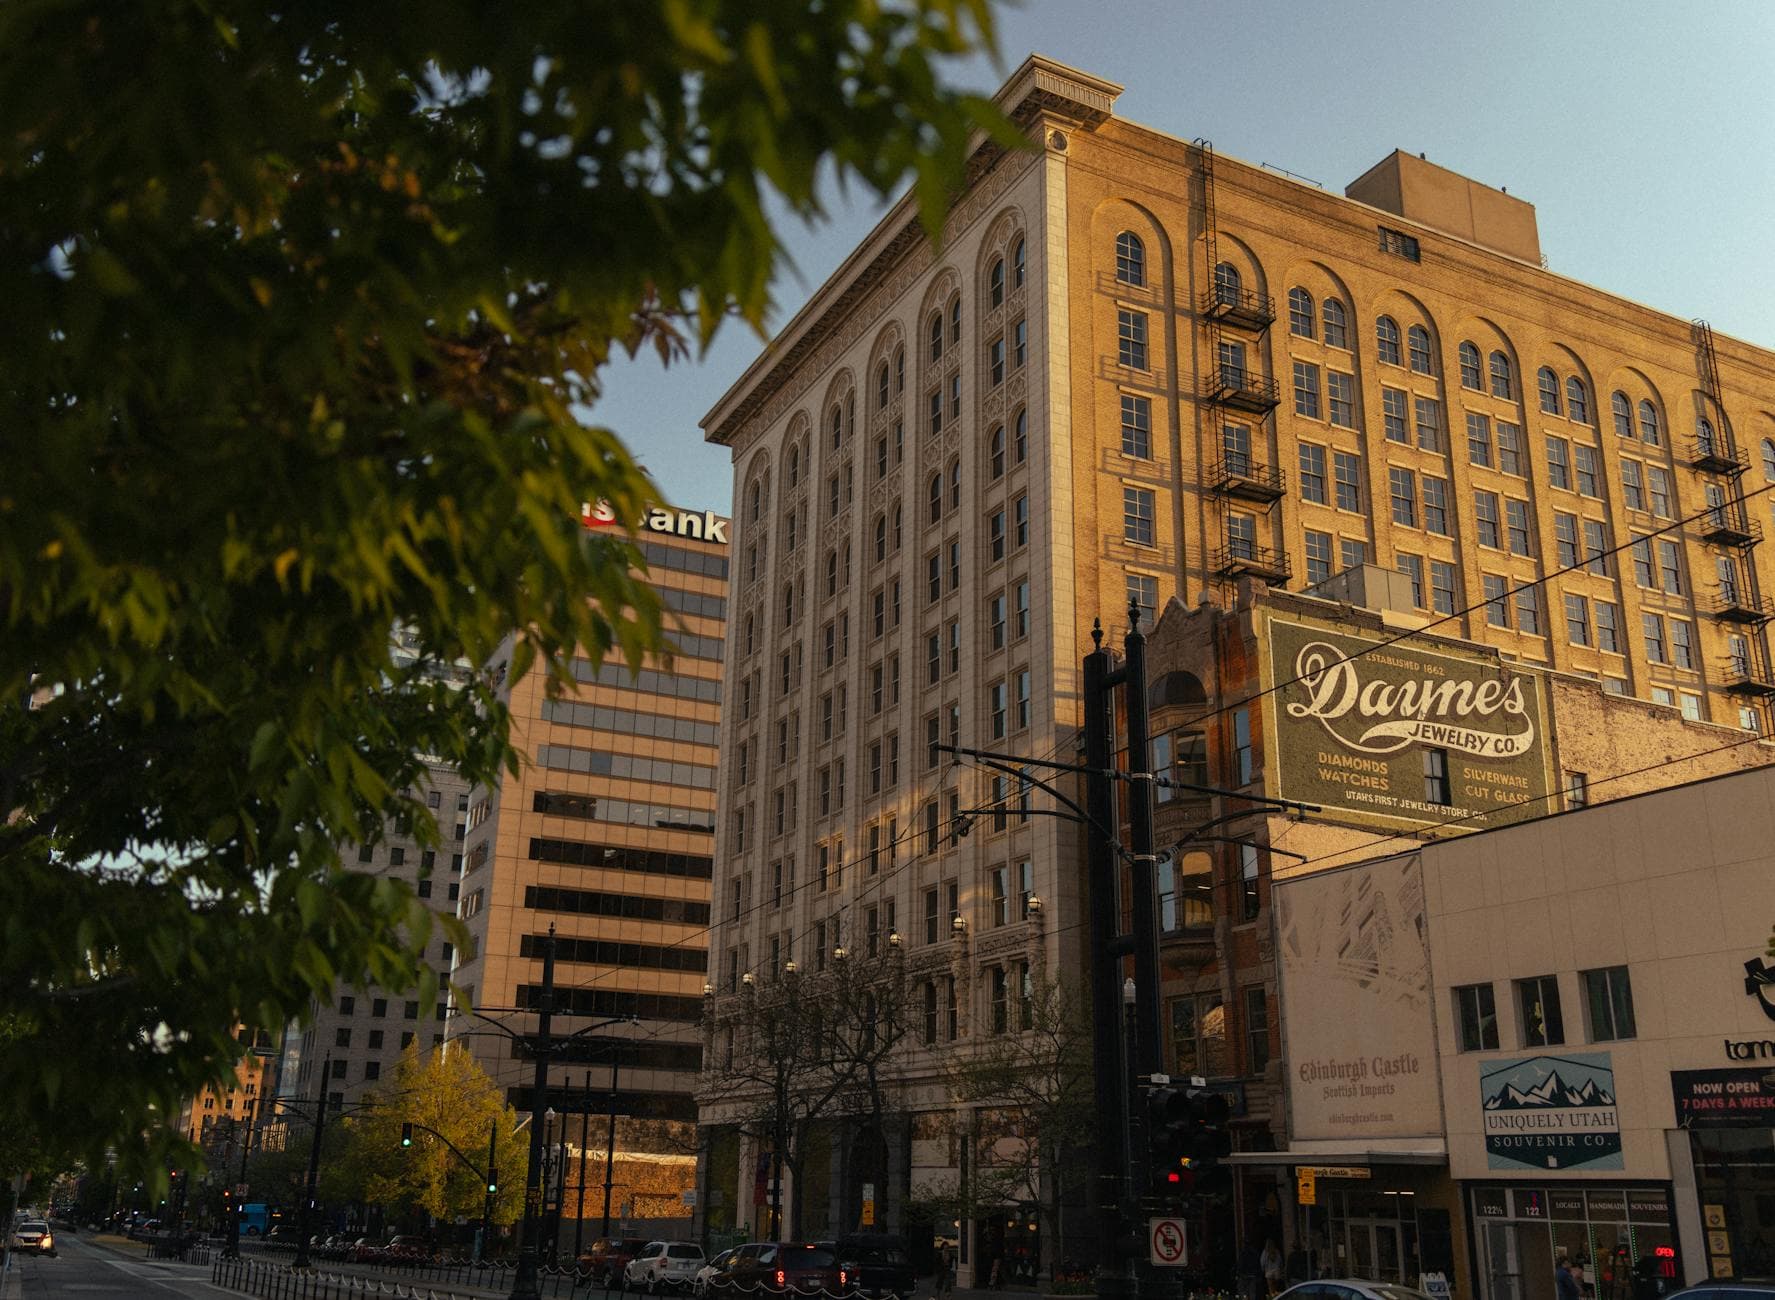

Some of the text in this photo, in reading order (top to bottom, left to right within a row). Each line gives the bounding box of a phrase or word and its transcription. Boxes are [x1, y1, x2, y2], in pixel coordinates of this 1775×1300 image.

[638, 504, 729, 544] ank
[1366, 653, 1445, 676] ESTABLISHED 1862
[1287, 642, 1527, 721] Daynes
[1408, 723, 1520, 753] JEWELRY CO.
[1318, 751, 1388, 775] DIAMONDS
[1318, 767, 1390, 791] WATCHES
[1463, 767, 1529, 789] SILVERWARE
[1345, 790, 1374, 803] UTAH'S
[1374, 795, 1398, 807] FIRST
[1399, 799, 1440, 813] JEWELRY
[1440, 805, 1469, 818] STORE
[1465, 785, 1531, 806] CUT GLASS
[1299, 1053, 1419, 1085] Edinburgh Castle
[1323, 1083, 1396, 1100] Scottish Imports
[1693, 1081, 1760, 1095] NOW OPEN
[1682, 1095, 1775, 1109] 7 DAYS A WEEK
[1488, 1112, 1616, 1131] UNIQUELY UTAH
[1494, 1135, 1613, 1147] SOUVENIR CO.
[1525, 1206, 1540, 1216] 122
[1655, 1247, 1675, 1257] OPEN
